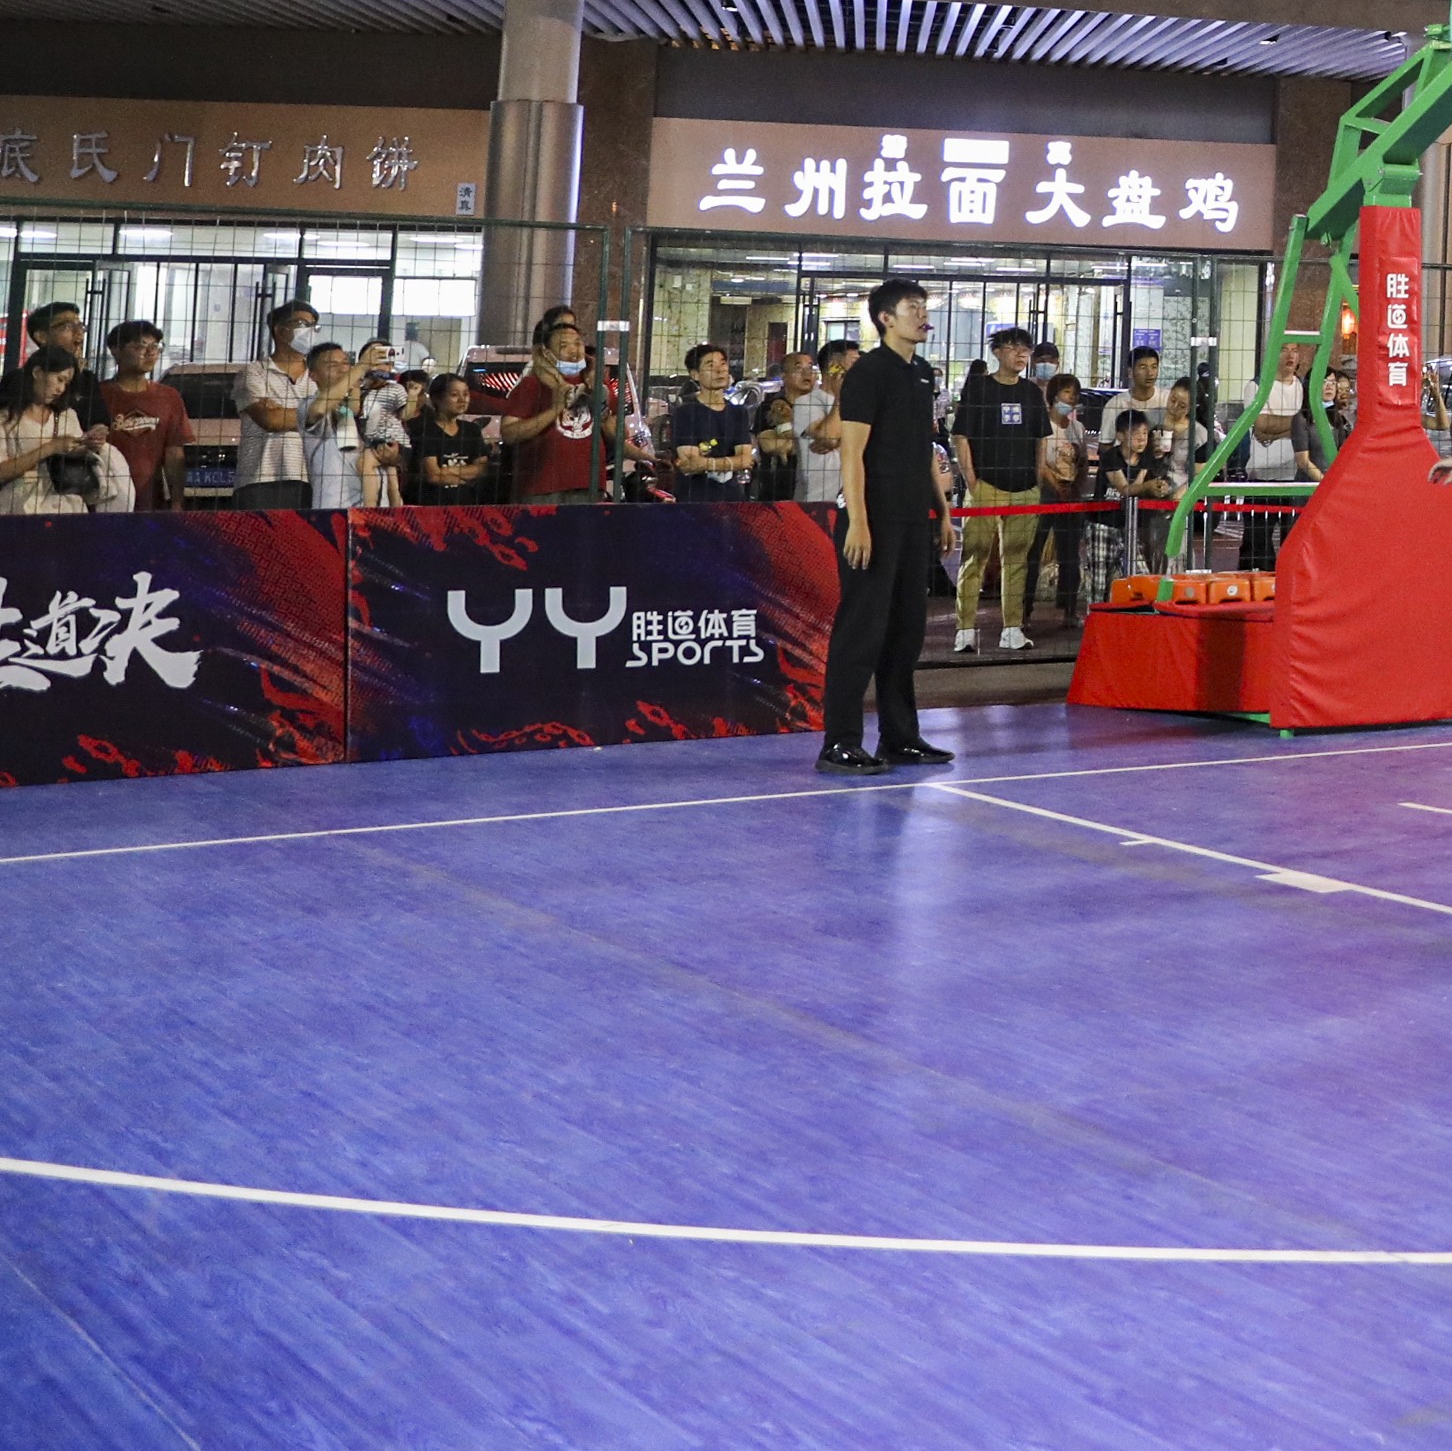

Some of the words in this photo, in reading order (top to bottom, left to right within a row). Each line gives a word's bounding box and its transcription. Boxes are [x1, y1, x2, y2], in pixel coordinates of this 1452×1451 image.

[699, 148, 1240, 232] 兰州拉面大盘鸡
[1385, 273, 1410, 387] 胜道体育
[632, 608, 758, 642] 胜道体育
